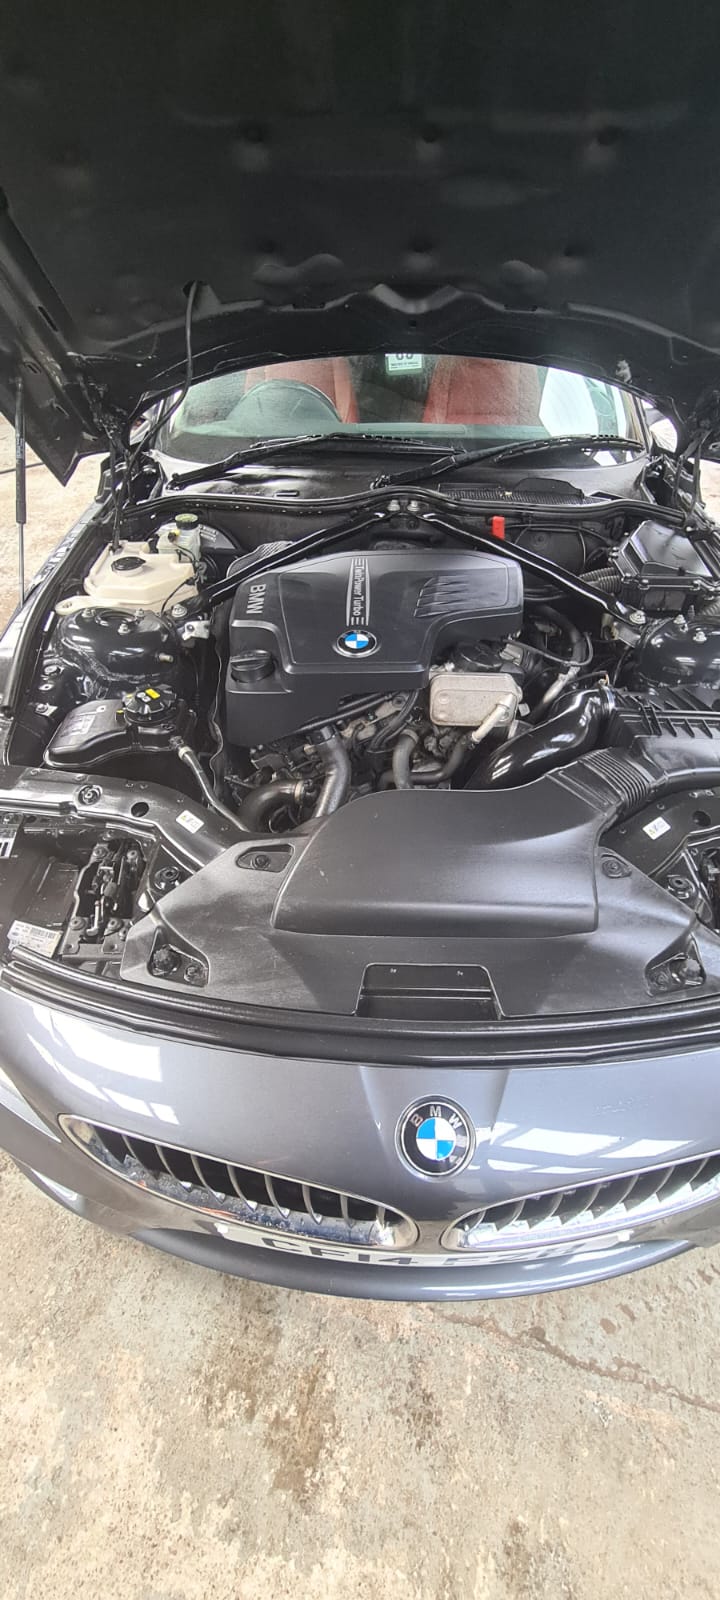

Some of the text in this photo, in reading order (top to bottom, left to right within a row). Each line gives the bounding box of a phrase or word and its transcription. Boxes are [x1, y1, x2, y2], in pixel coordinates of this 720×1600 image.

[246, 584, 266, 613] BMW
[353, 596, 364, 616] Turbo
[409, 1105, 462, 1129] BMW
[261, 1237, 418, 1265] CF14
